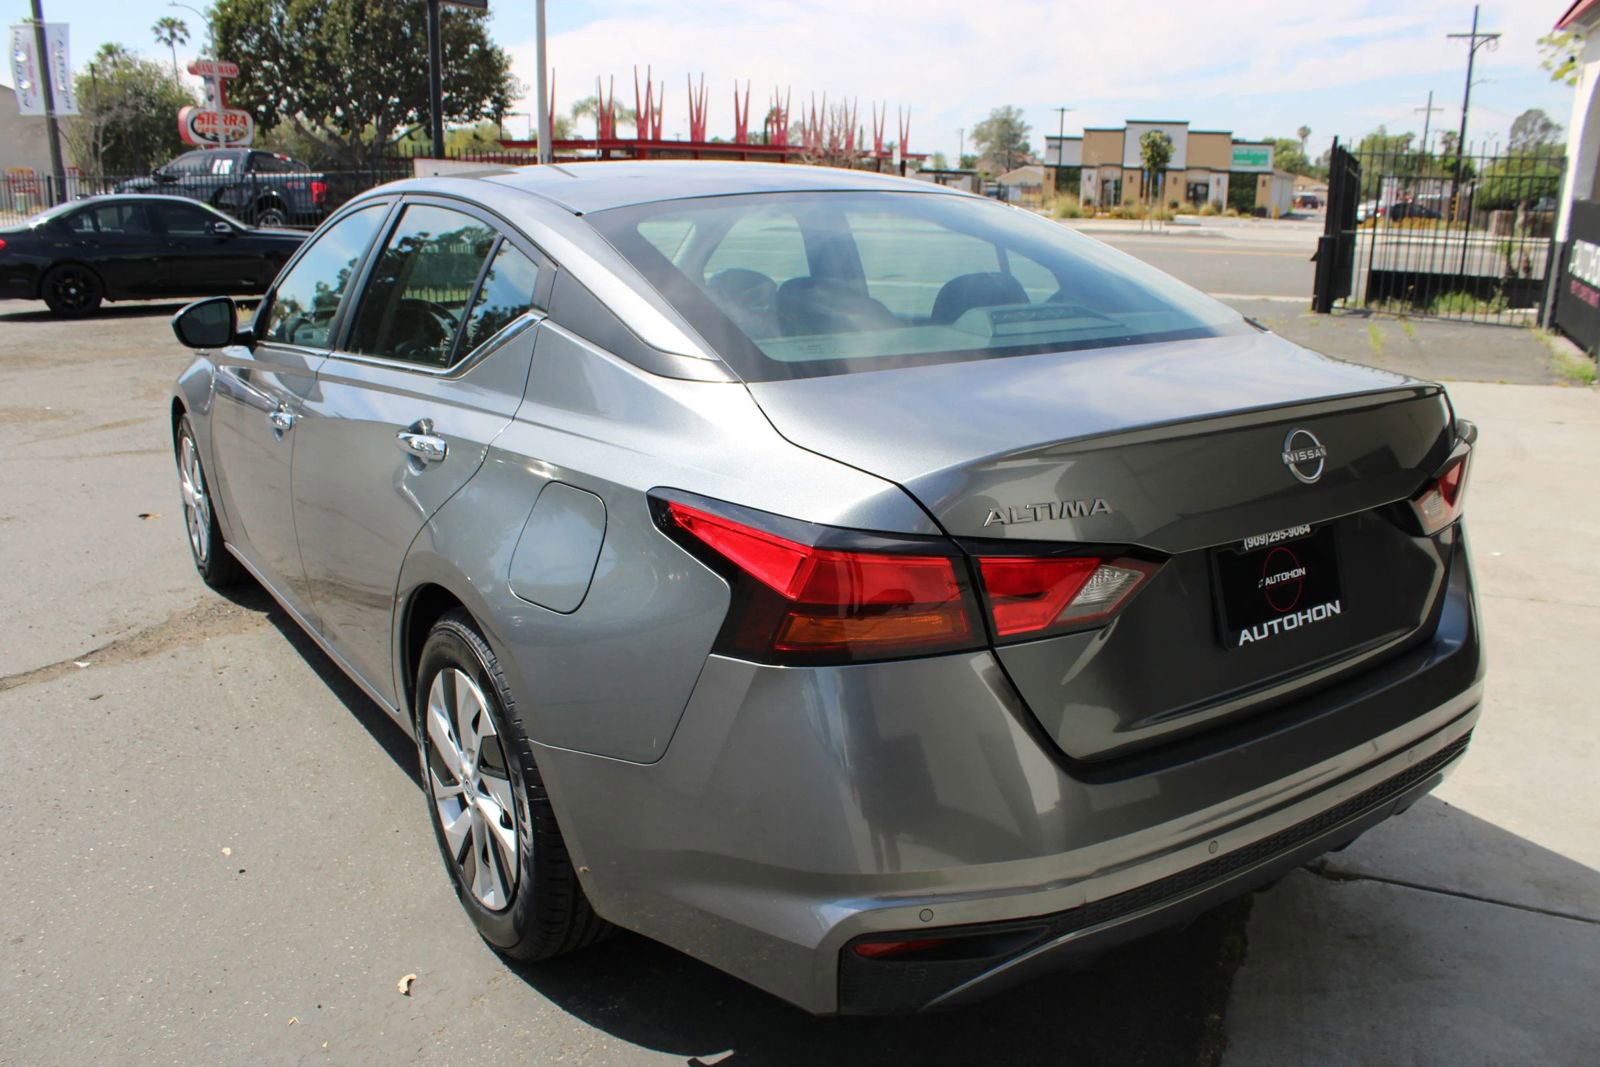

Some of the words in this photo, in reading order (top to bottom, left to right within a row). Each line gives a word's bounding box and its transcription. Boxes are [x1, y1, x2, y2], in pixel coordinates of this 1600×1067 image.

[1284, 446, 1326, 465] NISSAN
[983, 498, 1113, 528] ALTIMA
[1265, 567, 1307, 586] AUTOHON
[1238, 599, 1342, 647] AUTOHON
